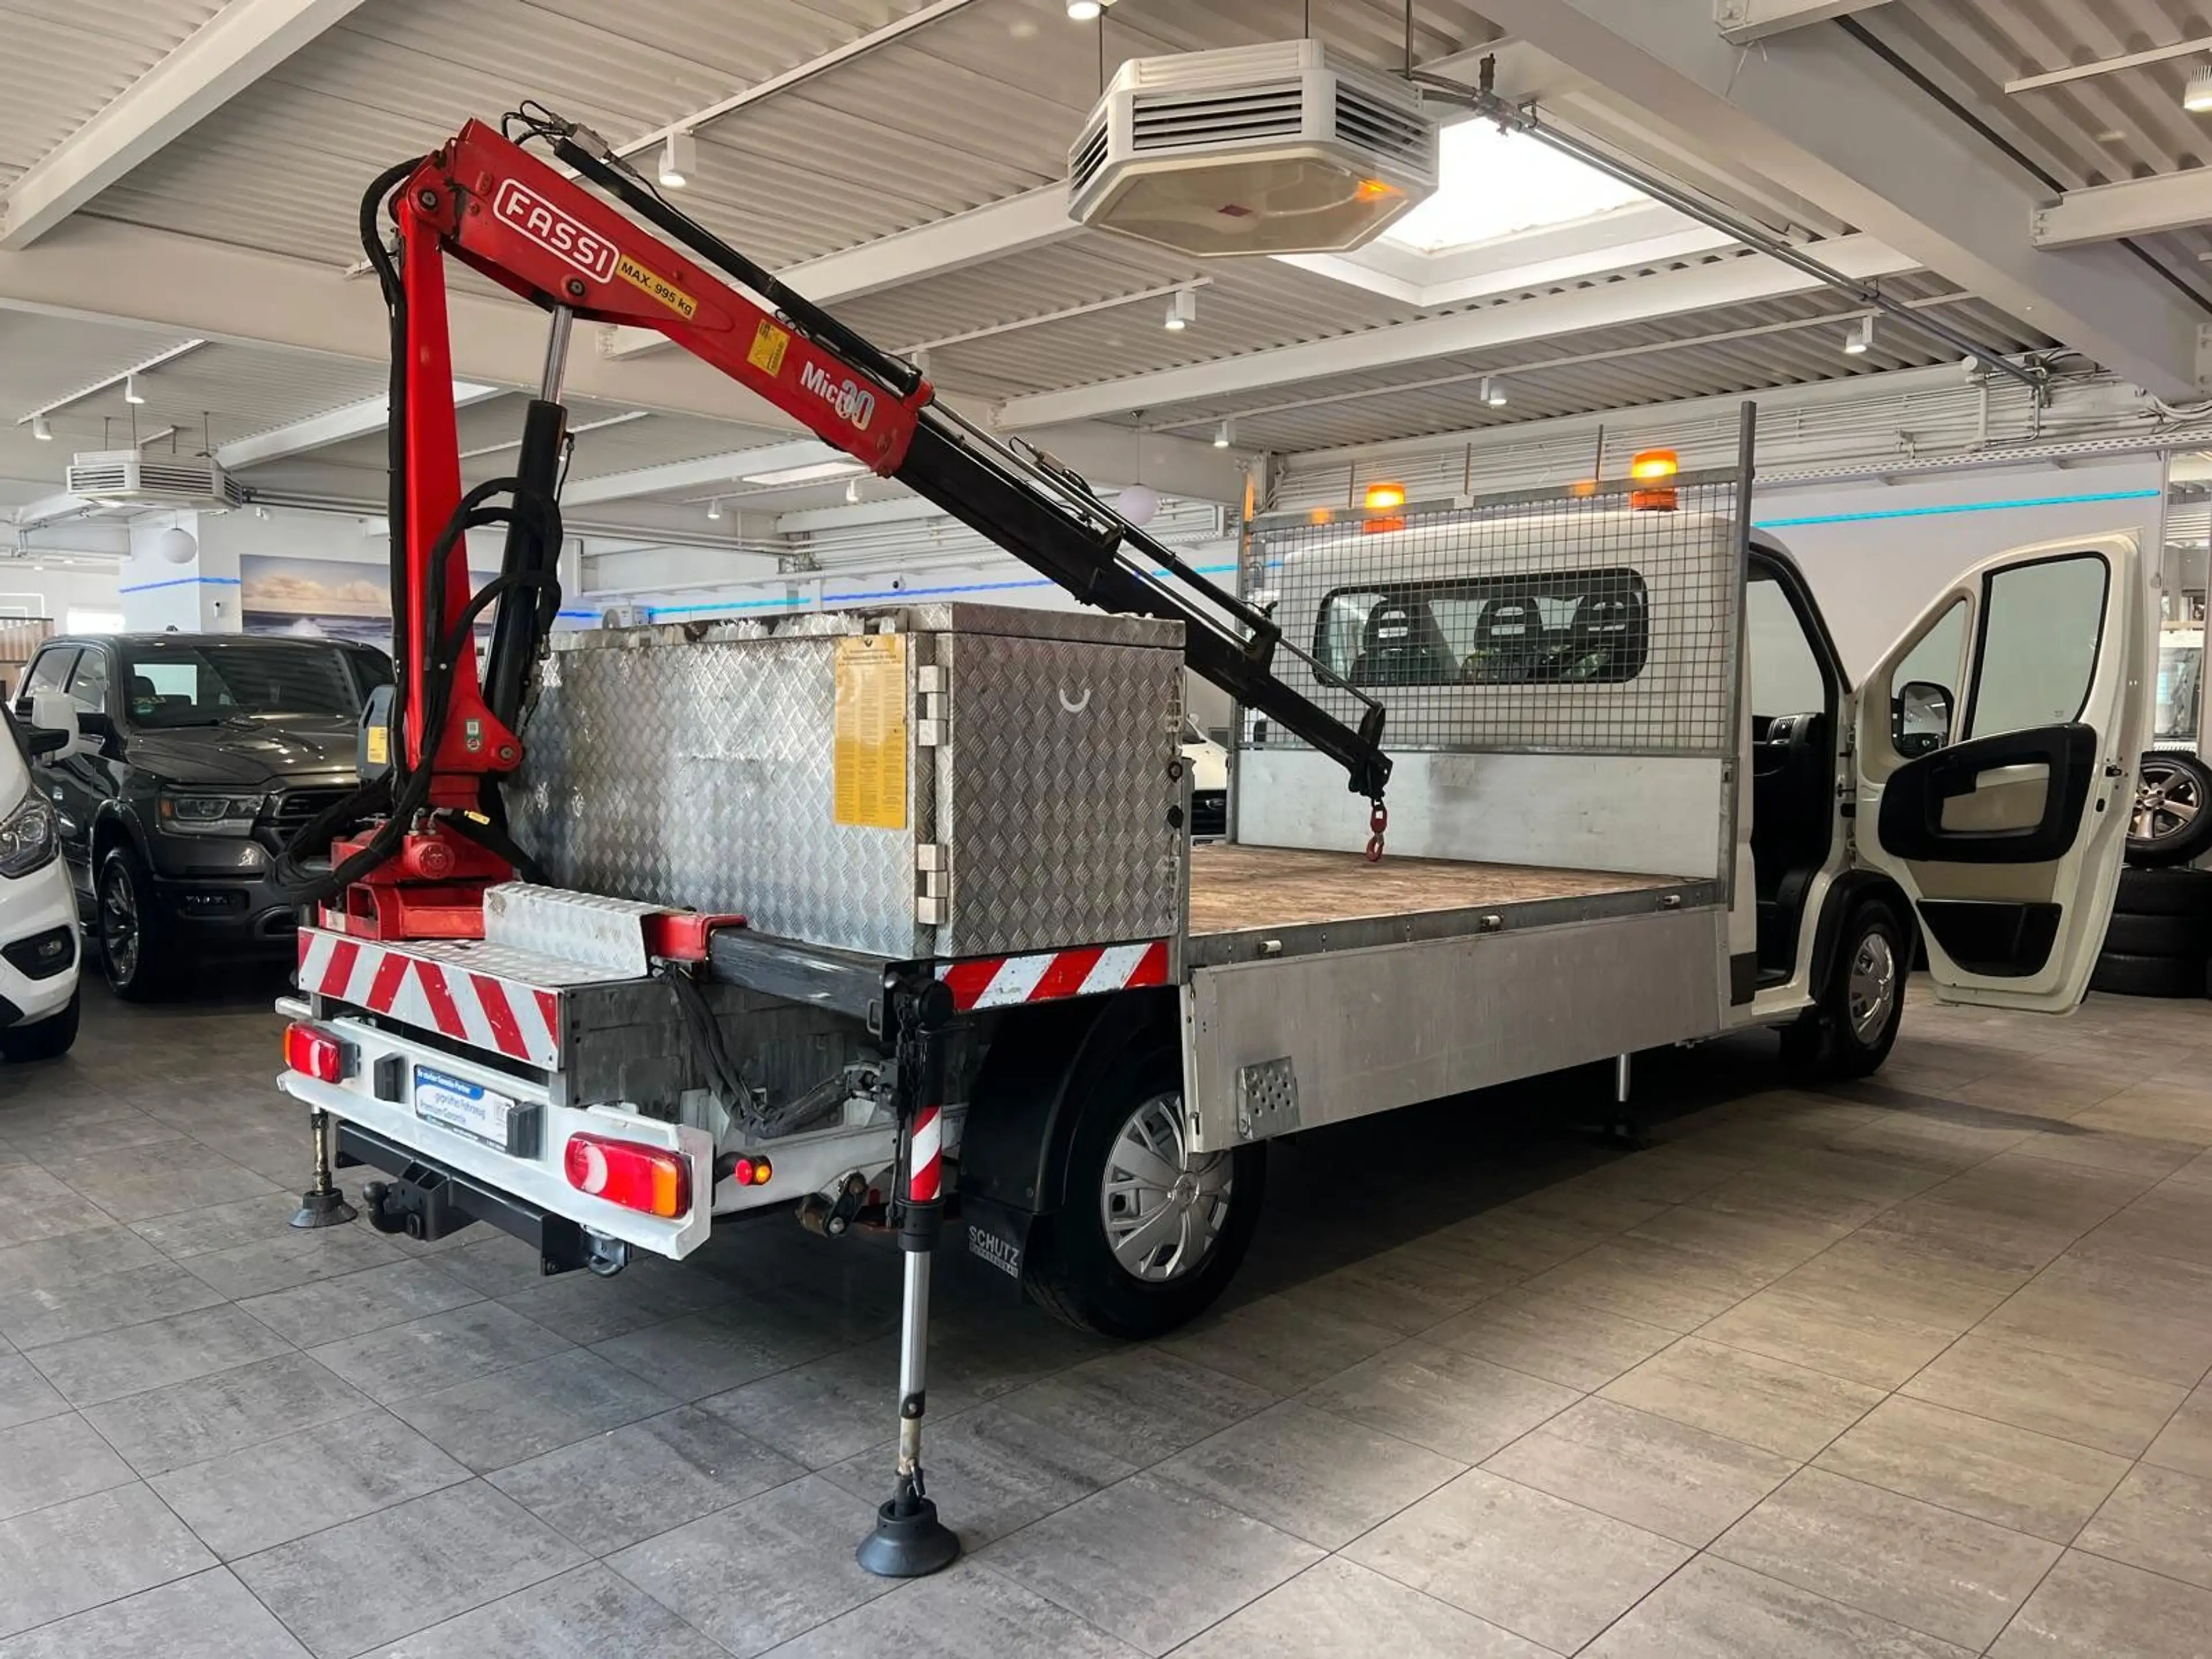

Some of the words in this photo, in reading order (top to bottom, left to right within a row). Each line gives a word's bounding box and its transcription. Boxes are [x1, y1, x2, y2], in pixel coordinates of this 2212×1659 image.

[506, 191, 608, 272] FASSI
[621, 262, 652, 289] MAX.
[654, 283, 676, 302] 995
[677, 298, 693, 315] kg
[969, 1225, 1020, 1267] SCHUTZ
